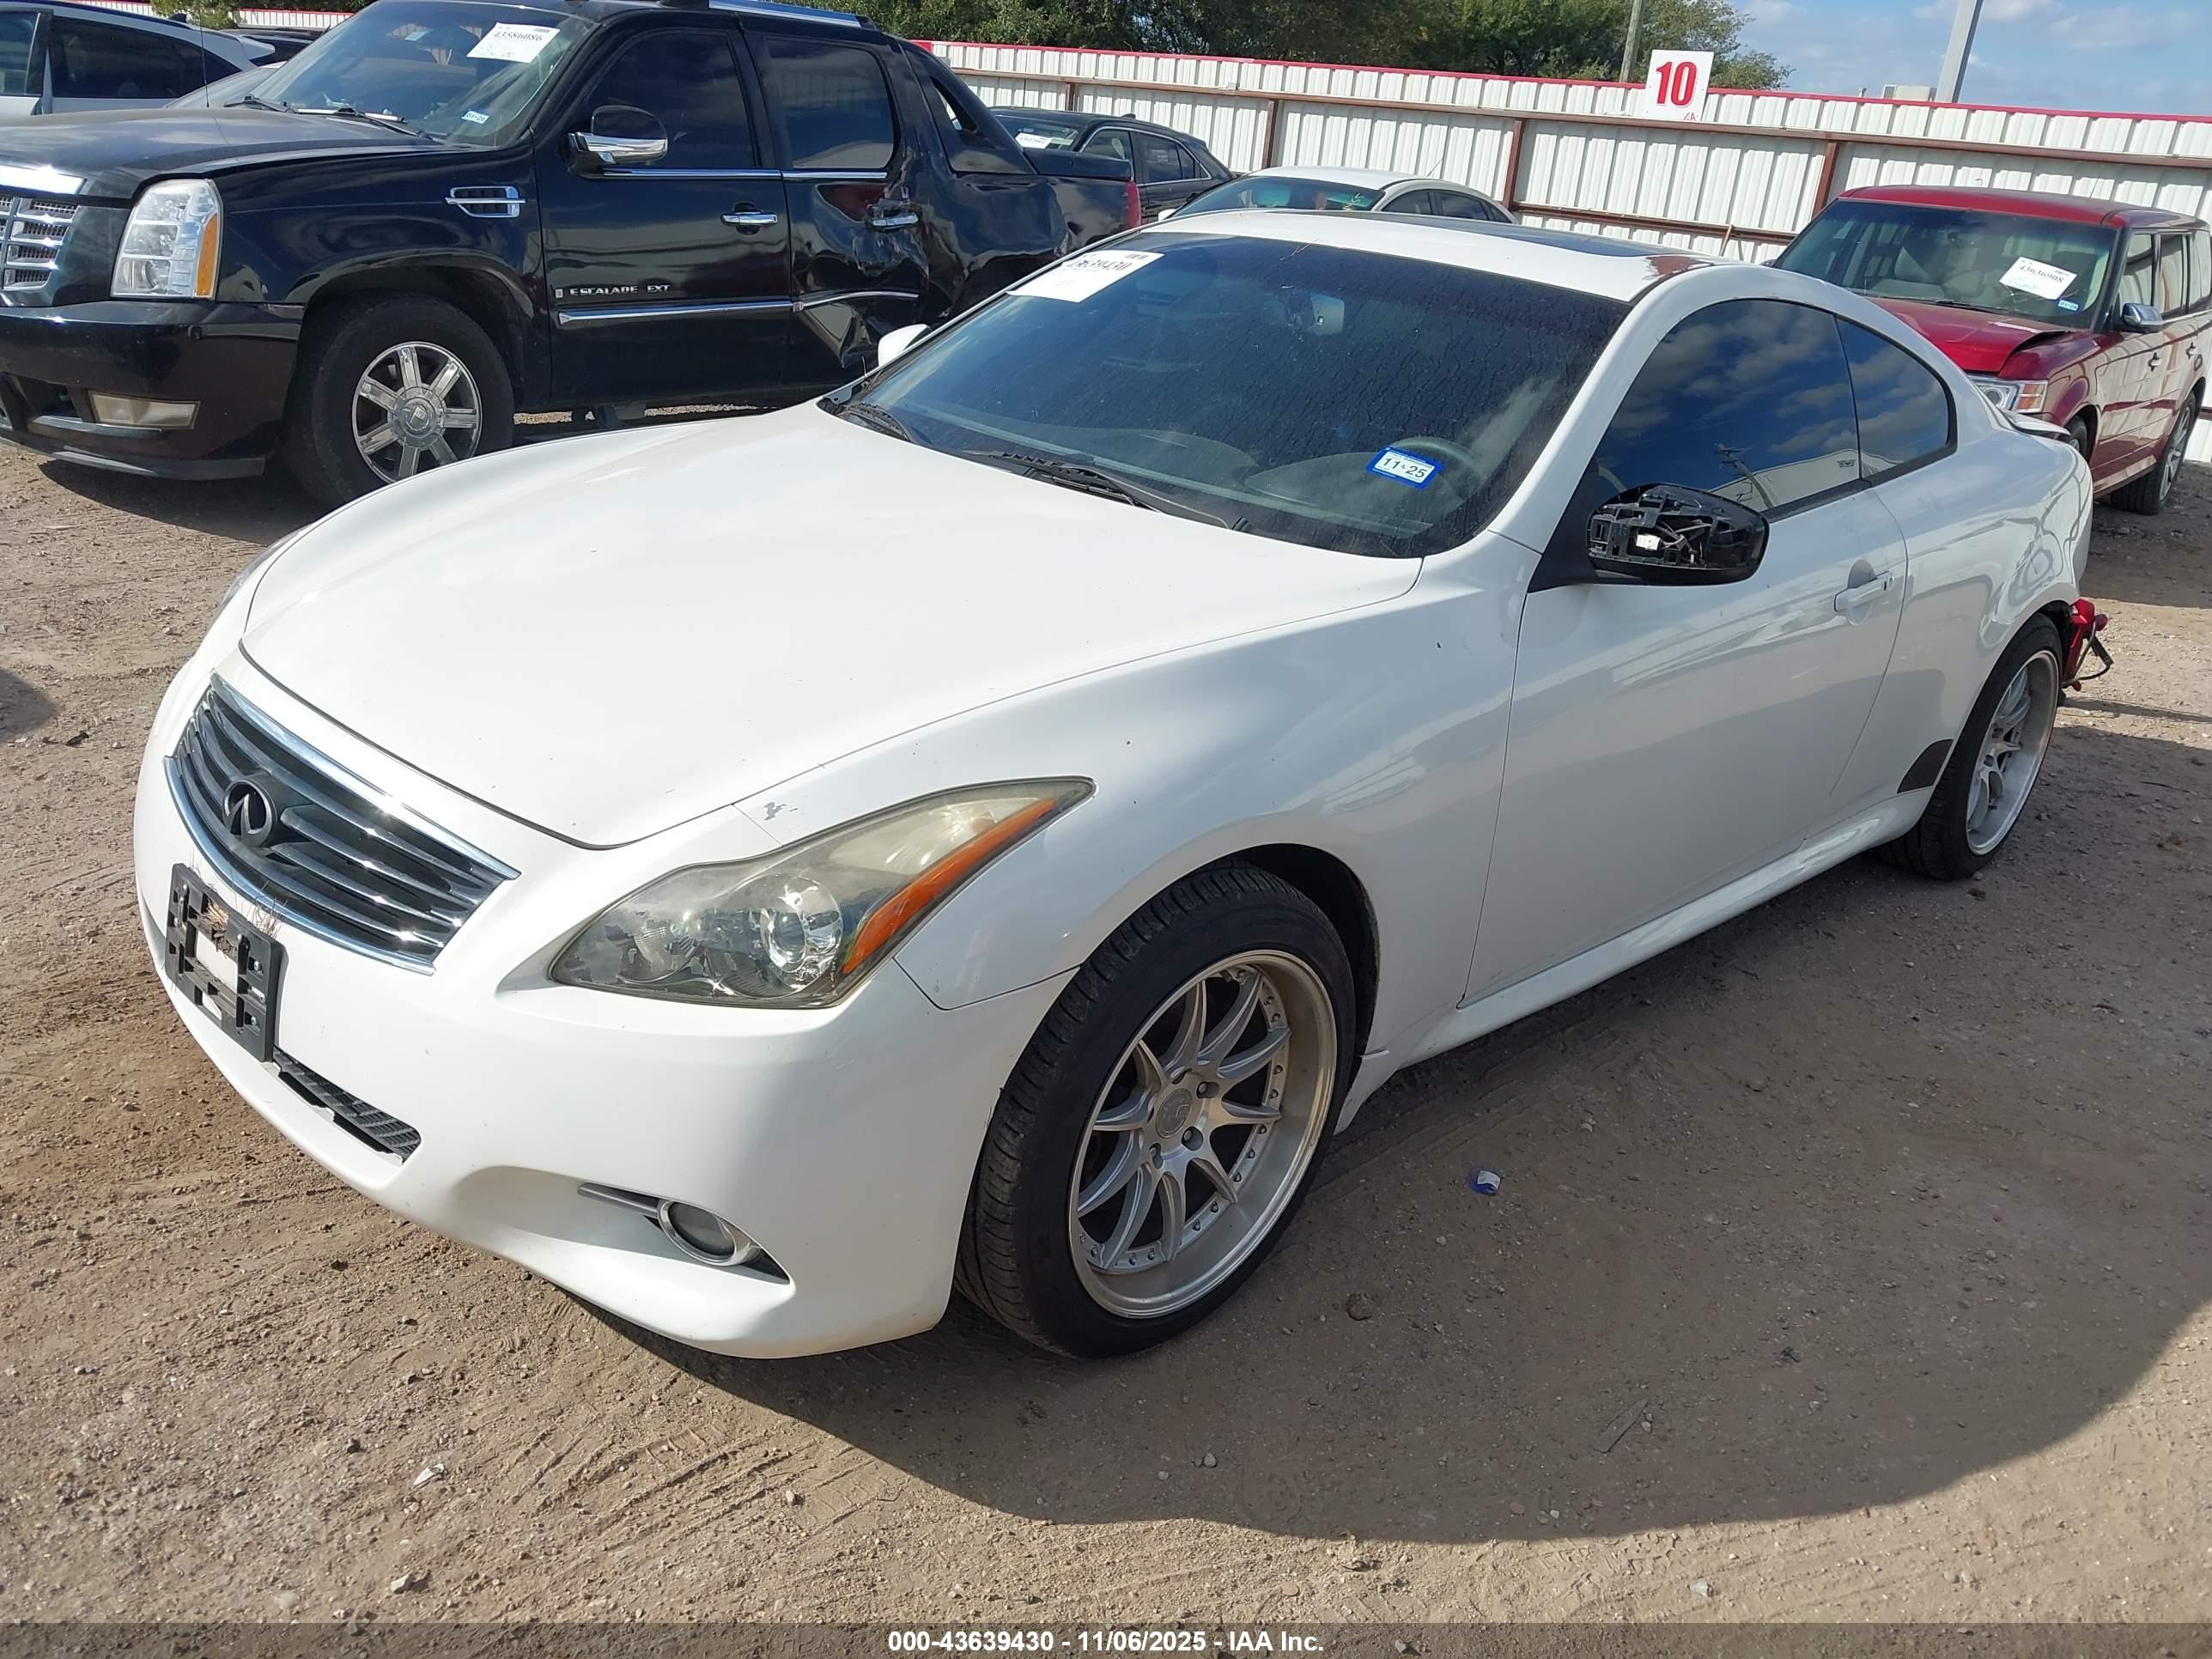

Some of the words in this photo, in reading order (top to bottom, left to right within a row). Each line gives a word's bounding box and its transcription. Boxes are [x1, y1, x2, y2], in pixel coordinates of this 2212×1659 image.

[1656, 61, 1697, 106] 10
[569, 285, 638, 295] ESCALADE
[647, 284, 670, 293] EXT
